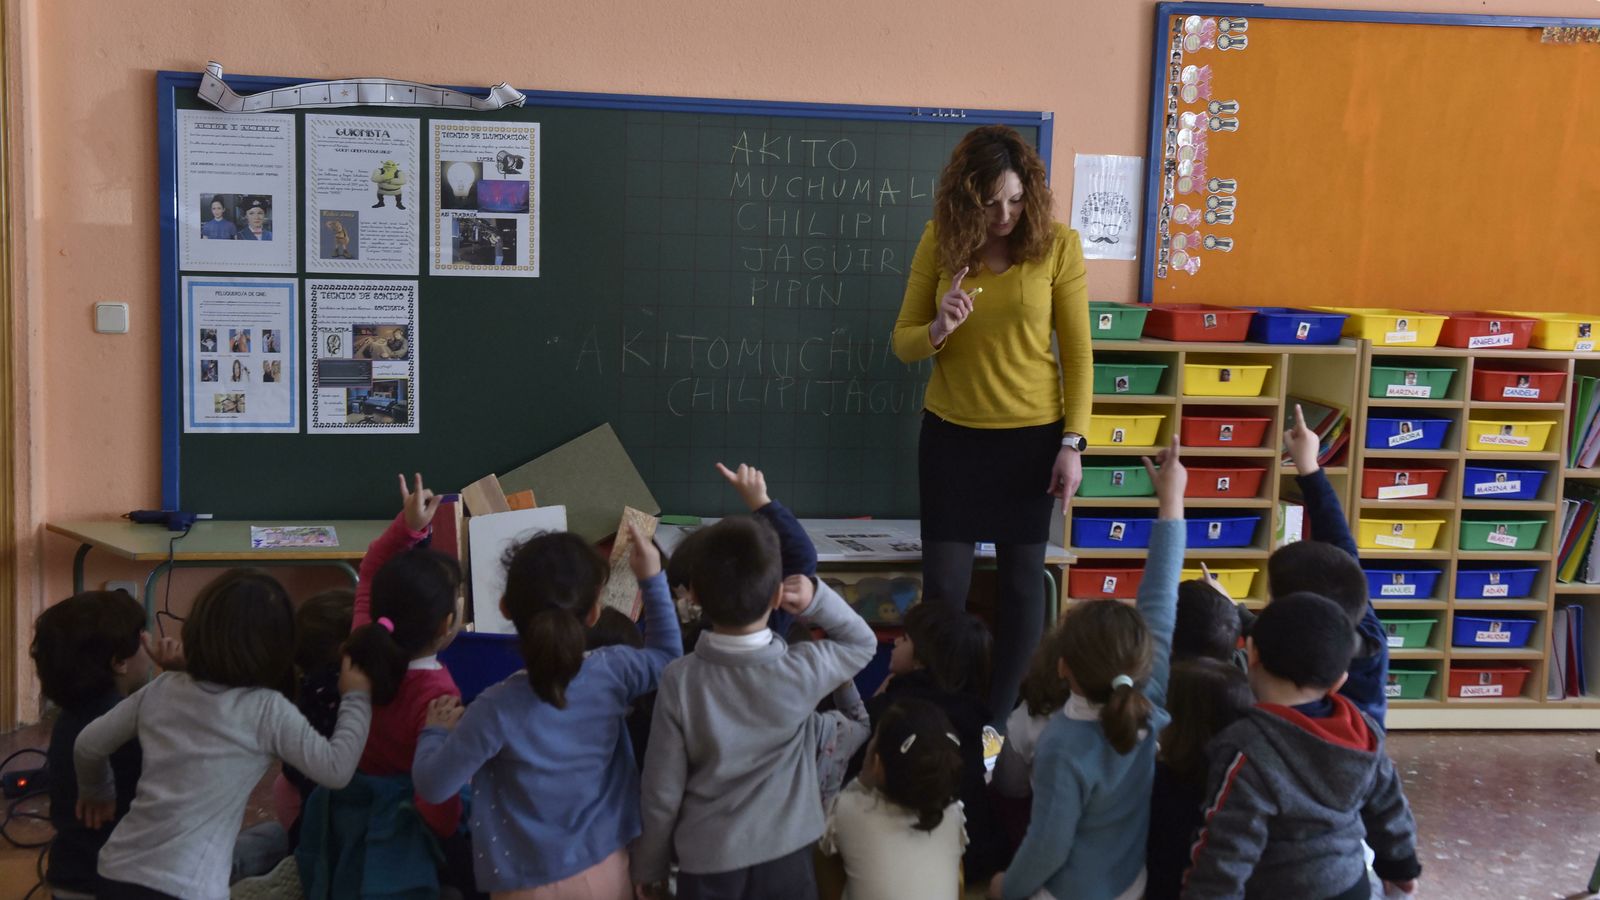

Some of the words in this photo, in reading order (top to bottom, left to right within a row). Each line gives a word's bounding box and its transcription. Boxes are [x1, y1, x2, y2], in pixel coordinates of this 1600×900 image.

[335, 128, 391, 138] GUIONISTA
[730, 131, 857, 171] AKITO
[737, 202, 886, 238] CHILIPI
[358, 292, 371, 300] DE
[373, 292, 405, 300] SONIDO
[751, 275, 843, 307] PIPÍN
[1504, 388, 1538, 397] CANDELA
[1391, 431, 1421, 445] AURORA
[1476, 485, 1508, 493] MARINA
[1489, 534, 1514, 544] MARTA
[1383, 586, 1413, 594] MANUEL
